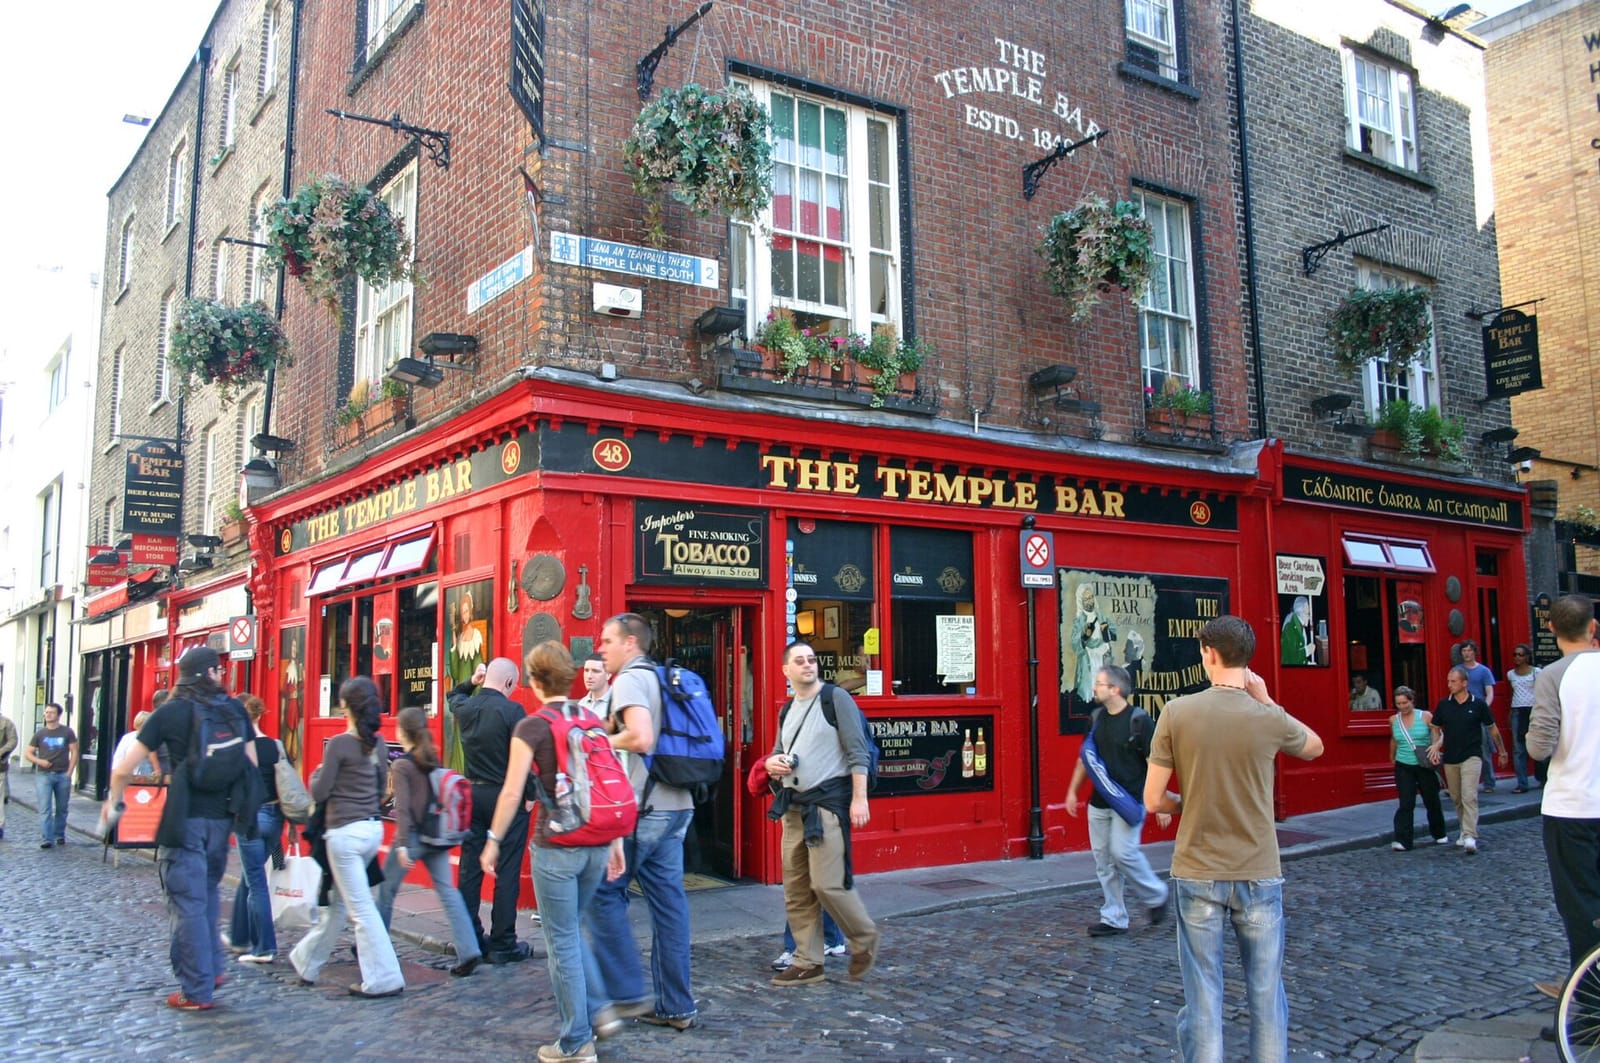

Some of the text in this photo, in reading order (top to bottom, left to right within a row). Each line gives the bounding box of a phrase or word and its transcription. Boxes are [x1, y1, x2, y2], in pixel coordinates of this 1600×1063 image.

[994, 37, 1047, 78] THE
[934, 66, 1101, 149] TEMPLE BAR
[964, 103, 1025, 141] ESTD.
[612, 246, 625, 257] AN
[587, 254, 694, 281] TEMPLE LANE SOUTH
[705, 266, 714, 281] 2
[1488, 323, 1532, 341] TEMPLE
[1499, 337, 1522, 350] BAR
[146, 446, 166, 454] THE
[505, 447, 516, 467] 48
[599, 443, 623, 463] 48
[128, 453, 183, 468] TEMPLE
[139, 463, 170, 477] BAR
[149, 490, 180, 498] GARDEN
[761, 455, 1126, 518] THE TEMPLE BAR
[307, 459, 473, 544] THE TEMPLE BAR
[150, 511, 176, 519] MUSIC
[1193, 505, 1206, 519] 48
[640, 510, 694, 533] Importers
[688, 530, 749, 542] FINE SMOKING
[655, 534, 750, 571] TOBACCO
[675, 564, 711, 575] Always
[729, 568, 757, 577] Stock
[1279, 560, 1291, 570] Beer
[1293, 560, 1315, 572] Garden
[794, 573, 817, 583] INNESS
[894, 573, 923, 584] GUINNESS
[1279, 570, 1303, 584] Smoking
[1092, 581, 1152, 599] TEMPLE
[1284, 583, 1298, 592] Area
[1112, 599, 1140, 616] BAR
[1196, 598, 1218, 617] THE
[404, 669, 416, 679] LIVE
[1135, 670, 1180, 690] MALTED
[411, 681, 425, 692] DAILY
[930, 720, 960, 736] BAR
[882, 739, 912, 747] DUBLIN
